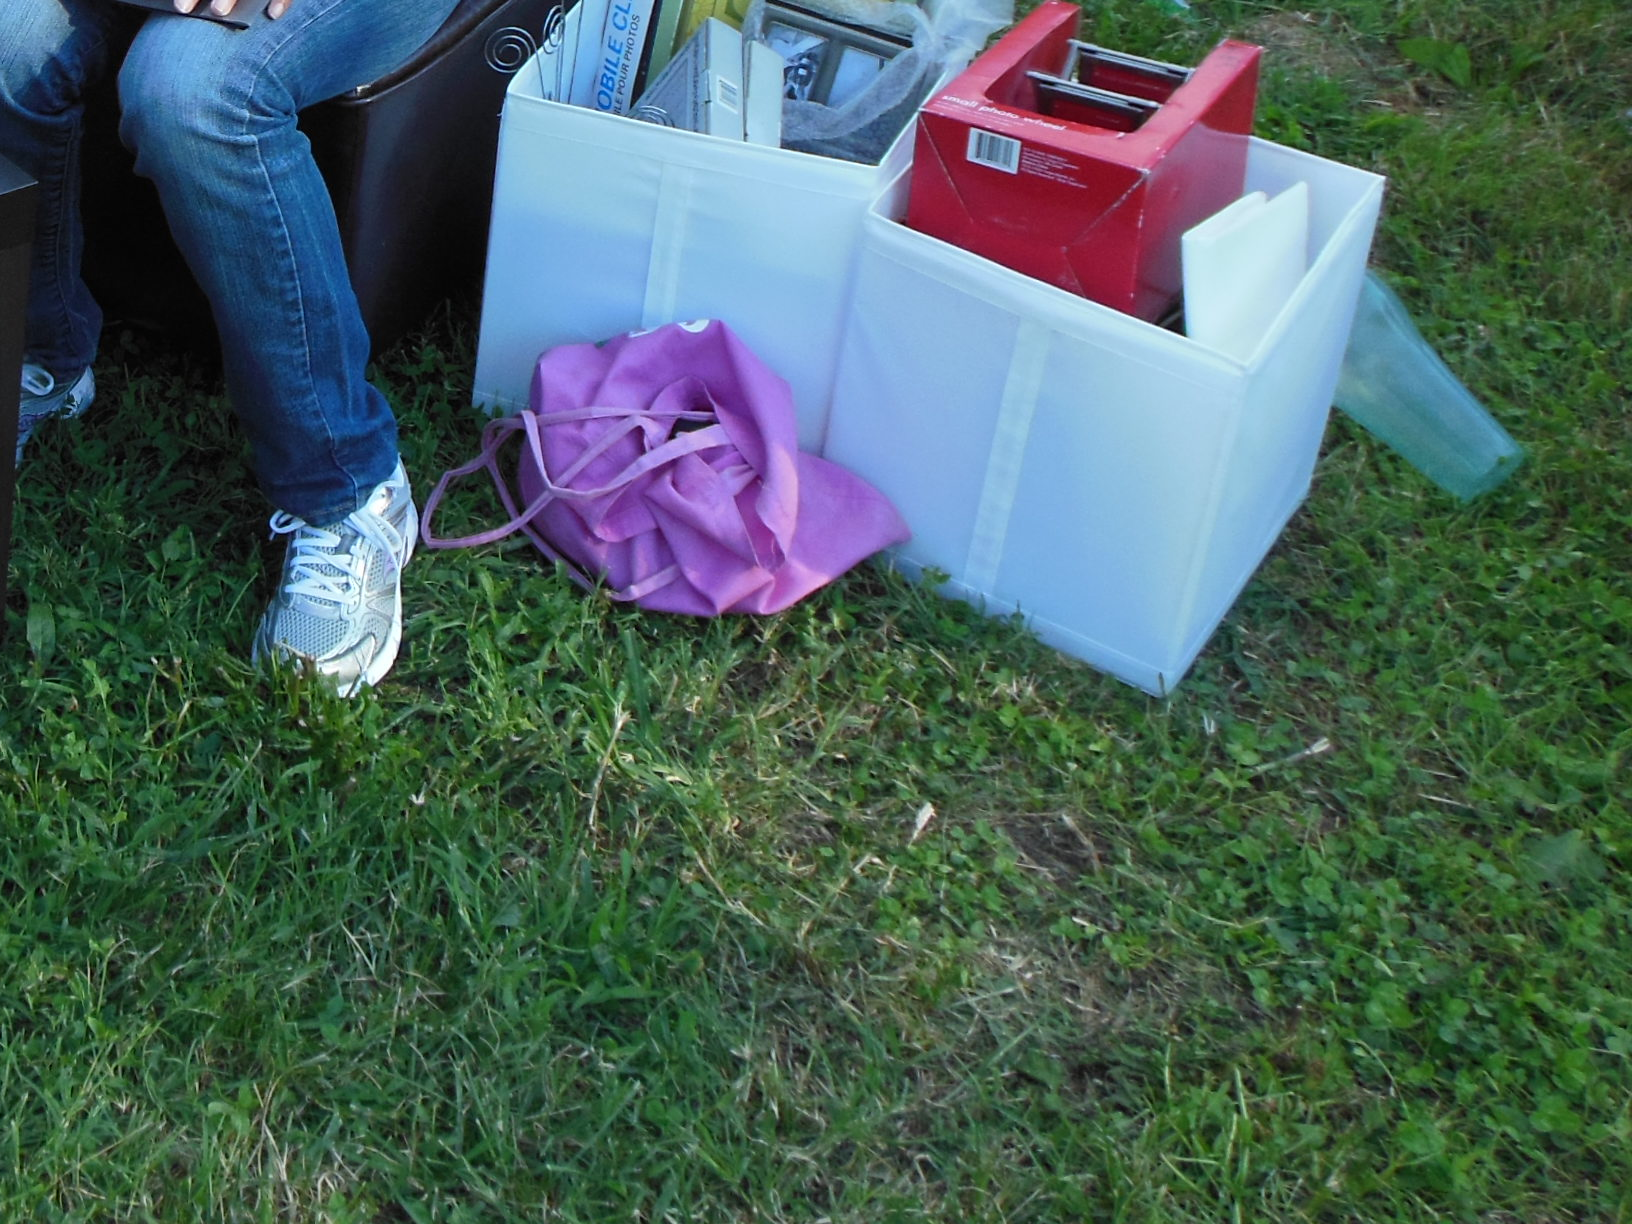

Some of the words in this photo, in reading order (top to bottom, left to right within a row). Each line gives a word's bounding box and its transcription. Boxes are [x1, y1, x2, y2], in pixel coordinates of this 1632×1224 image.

[597, 36, 623, 111] OBILE
[617, 63, 630, 95] POUR
[624, 14, 640, 62] PHOTOS
[942, 95, 978, 108] small
[978, 105, 1019, 120] photo
[1023, 116, 1067, 131] wheel
